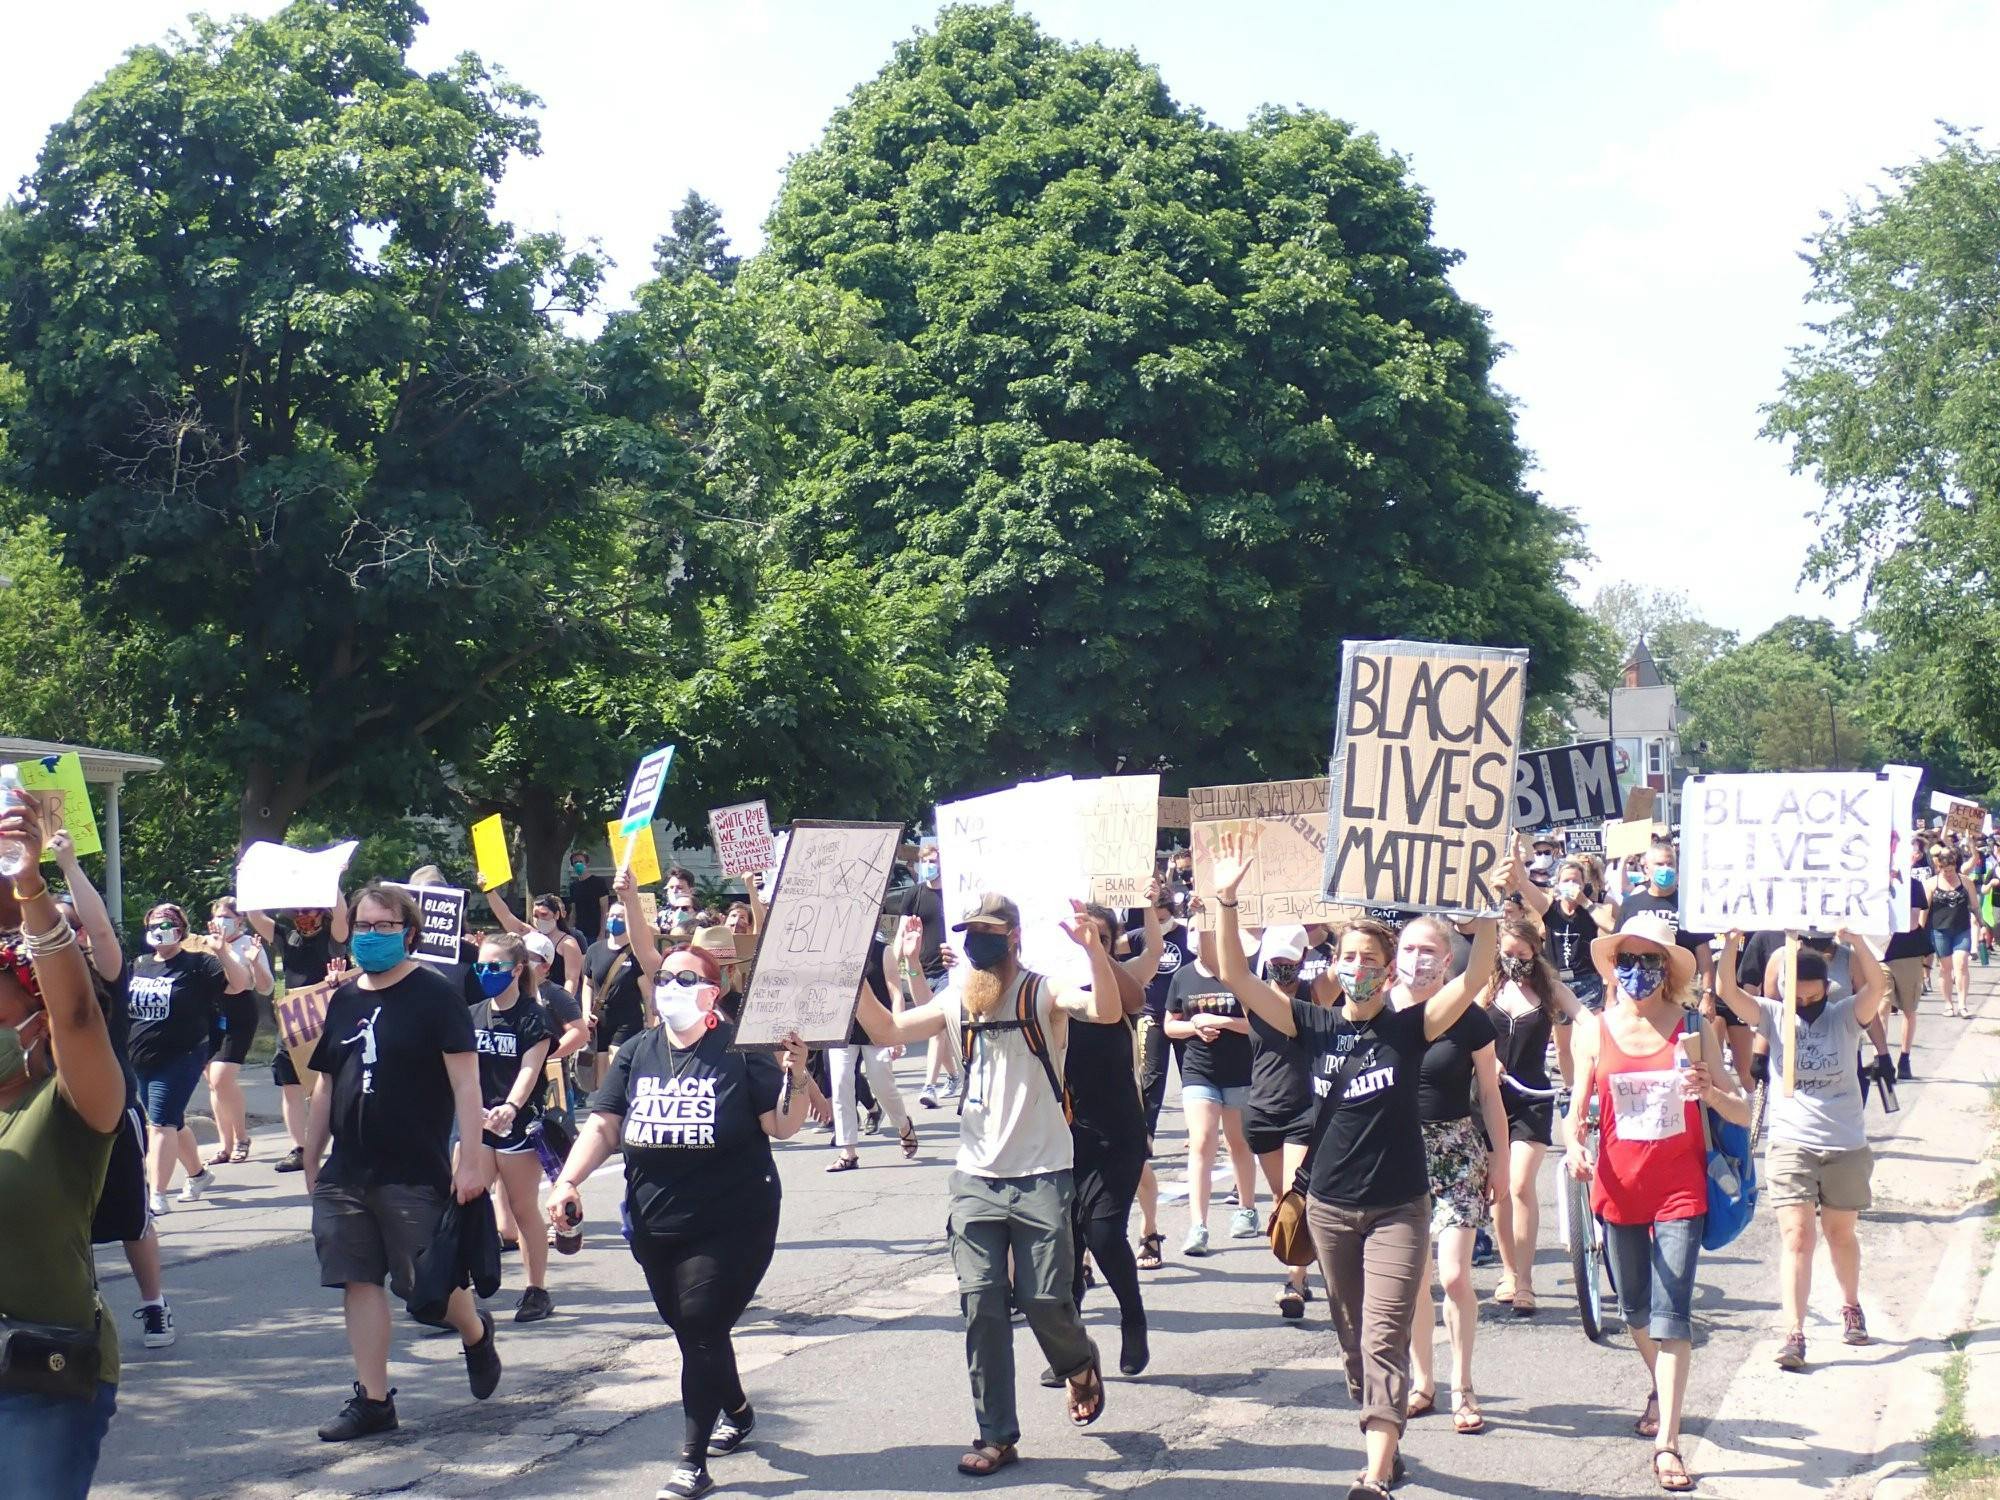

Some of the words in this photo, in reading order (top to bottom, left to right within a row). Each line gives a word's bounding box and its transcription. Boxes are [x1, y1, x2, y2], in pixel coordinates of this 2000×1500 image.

[1348, 654, 1519, 748] BLACK
[1297, 780, 1331, 811] ACK
[1342, 744, 1505, 832] LIVES
[1513, 745, 1617, 829] BLM
[1191, 786, 1251, 819] MATTER
[1704, 785, 1871, 828] BLACK
[716, 811, 744, 831] WHITE
[719, 828, 737, 843] WE
[741, 822, 766, 840] ARE
[724, 852, 773, 868] WHITE
[1702, 831, 1872, 873] LIVES
[726, 860, 775, 877] SUPREMACY
[1327, 825, 1503, 911] MATTER
[1105, 877, 1136, 891] BLAIR
[424, 898, 457, 916] BLACK
[1104, 894, 1136, 906] IMANI
[1700, 876, 1870, 917] MATTER
[424, 915, 454, 931] LIVES
[636, 1076, 718, 1097] BLACK
[1313, 1066, 1395, 1099] BRALITY
[632, 1098, 713, 1120] LIVES
[624, 1119, 716, 1146] MATTER
[648, 1142, 687, 1150] COMMUNITY
